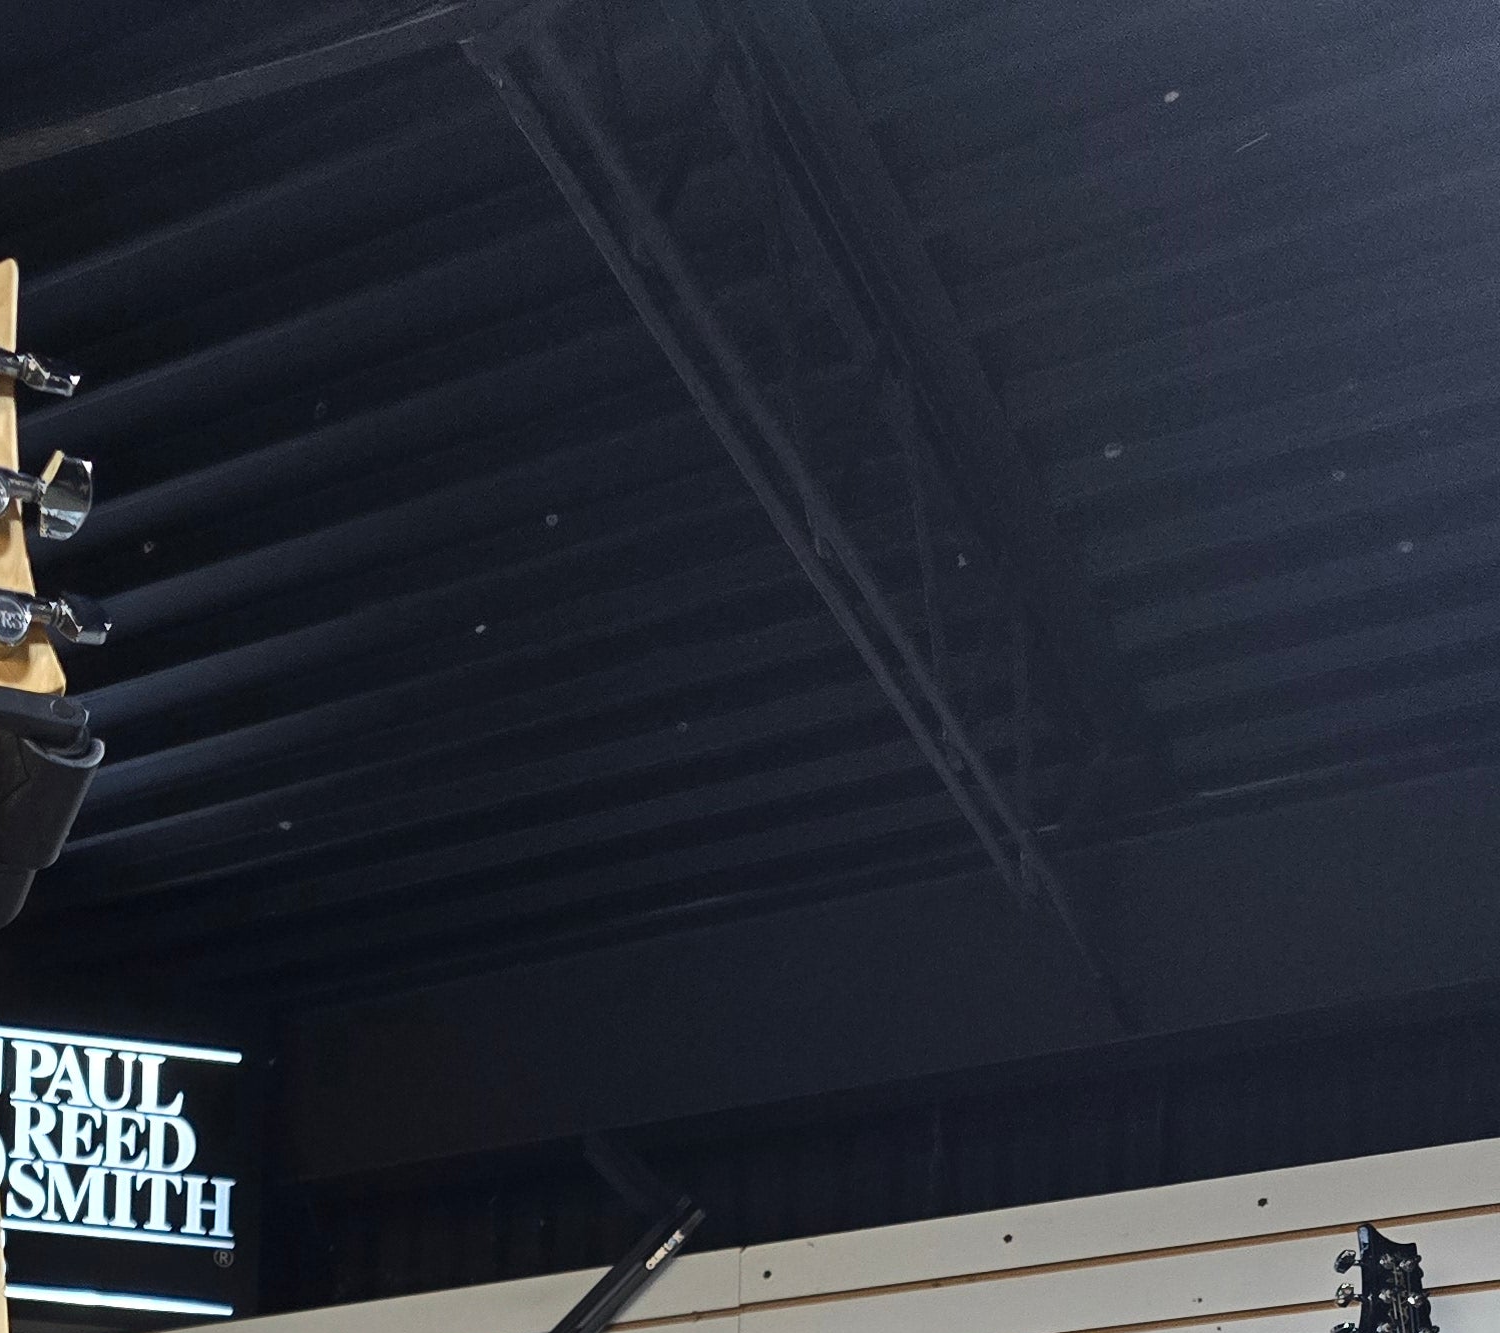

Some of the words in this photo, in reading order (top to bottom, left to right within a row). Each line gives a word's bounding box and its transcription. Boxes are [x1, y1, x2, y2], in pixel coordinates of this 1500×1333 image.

[11, 1039, 185, 1116] PAUL
[10, 1099, 197, 1174] REED
[7, 1160, 236, 1238] SMITH
